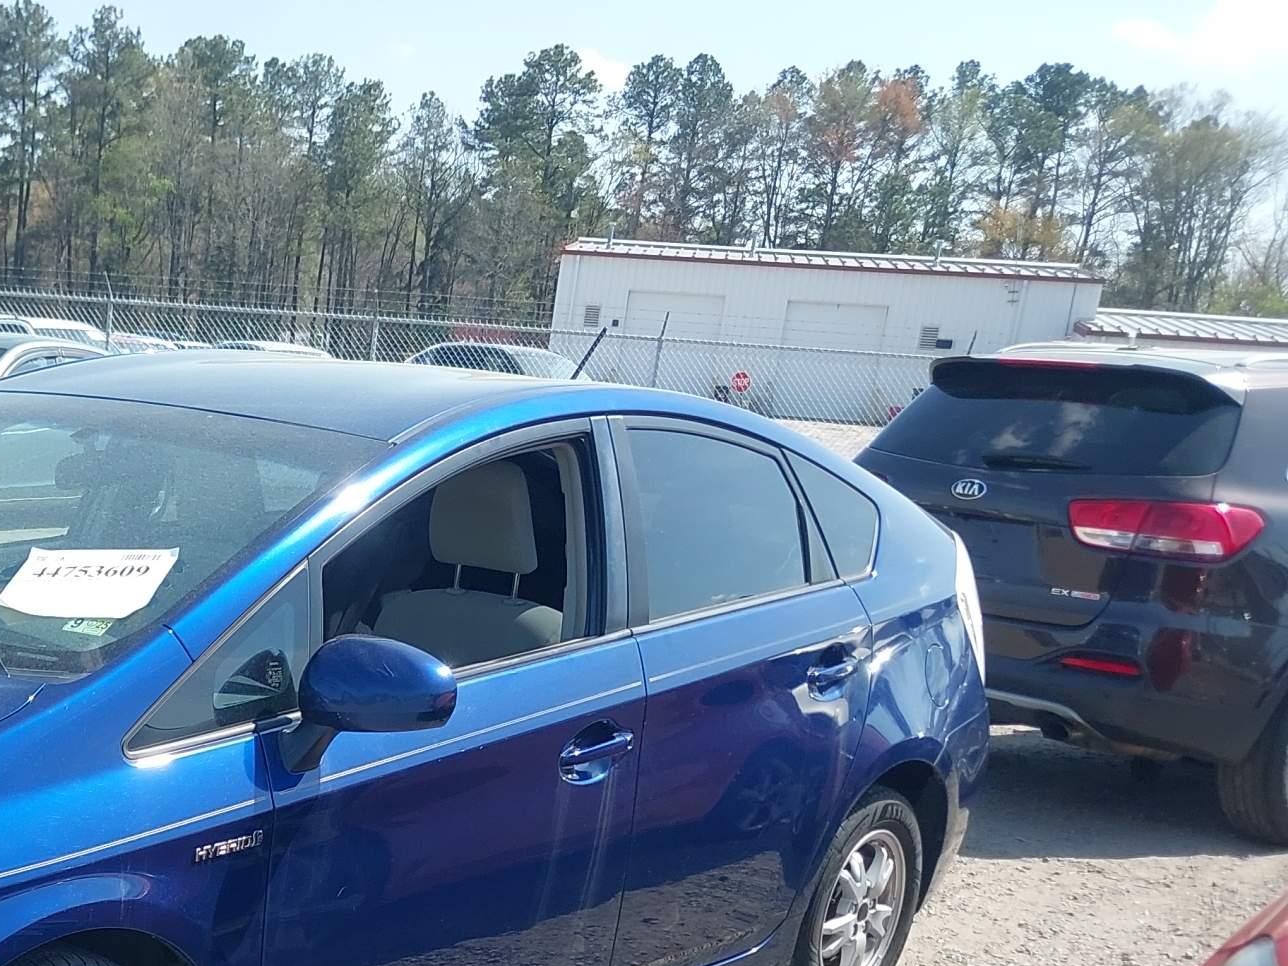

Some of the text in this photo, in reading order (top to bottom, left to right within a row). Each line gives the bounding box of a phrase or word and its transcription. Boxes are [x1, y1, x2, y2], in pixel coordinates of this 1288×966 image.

[955, 482, 979, 495] KIA
[32, 565, 150, 578] 44753609
[1051, 588, 1070, 597] EX
